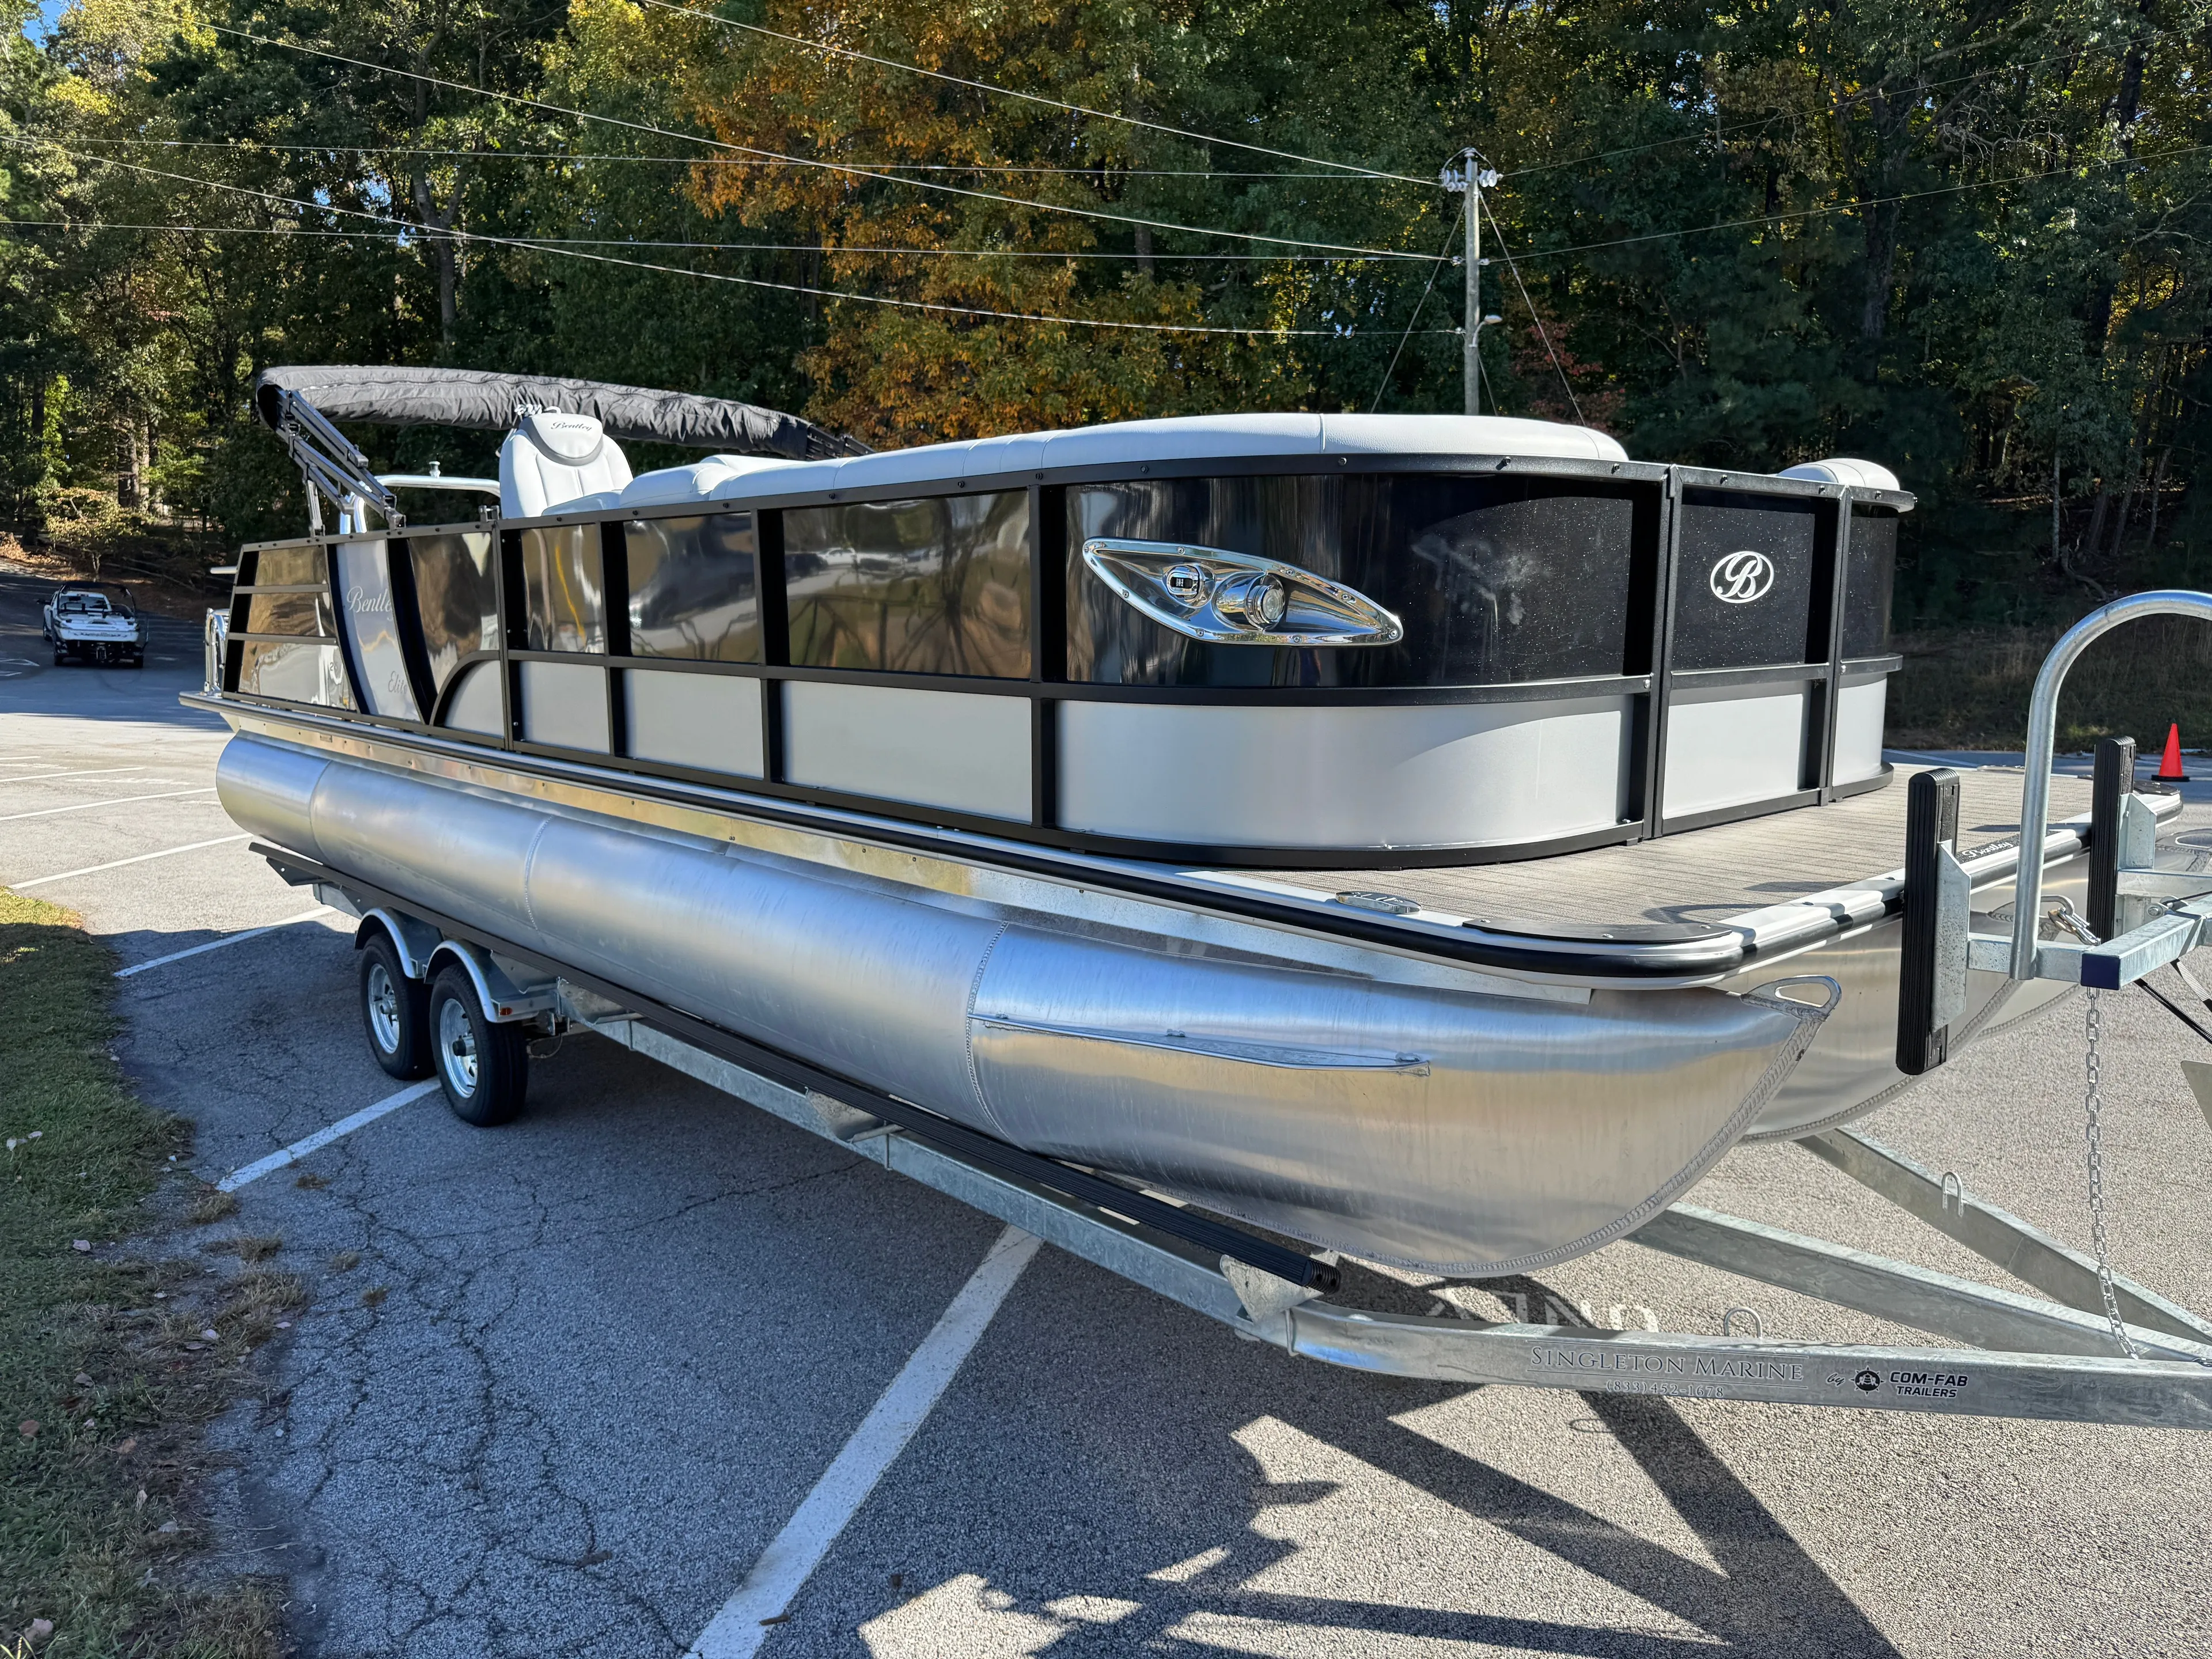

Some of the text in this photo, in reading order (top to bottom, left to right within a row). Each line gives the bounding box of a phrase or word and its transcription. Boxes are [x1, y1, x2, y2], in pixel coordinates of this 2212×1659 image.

[551, 422, 592, 431] Bentley
[1717, 552, 1763, 599] B
[388, 671, 408, 694] Elite
[1962, 842, 2014, 858] Bentley
[1532, 1347, 1804, 1381] SINGLETON MARINE
[1827, 1372, 1845, 1387] by
[1890, 1372, 1968, 1387] COM-FAB
[1606, 1380, 1724, 1397] (833)452-1678
[1896, 1385, 1957, 1398] TRAILERS
